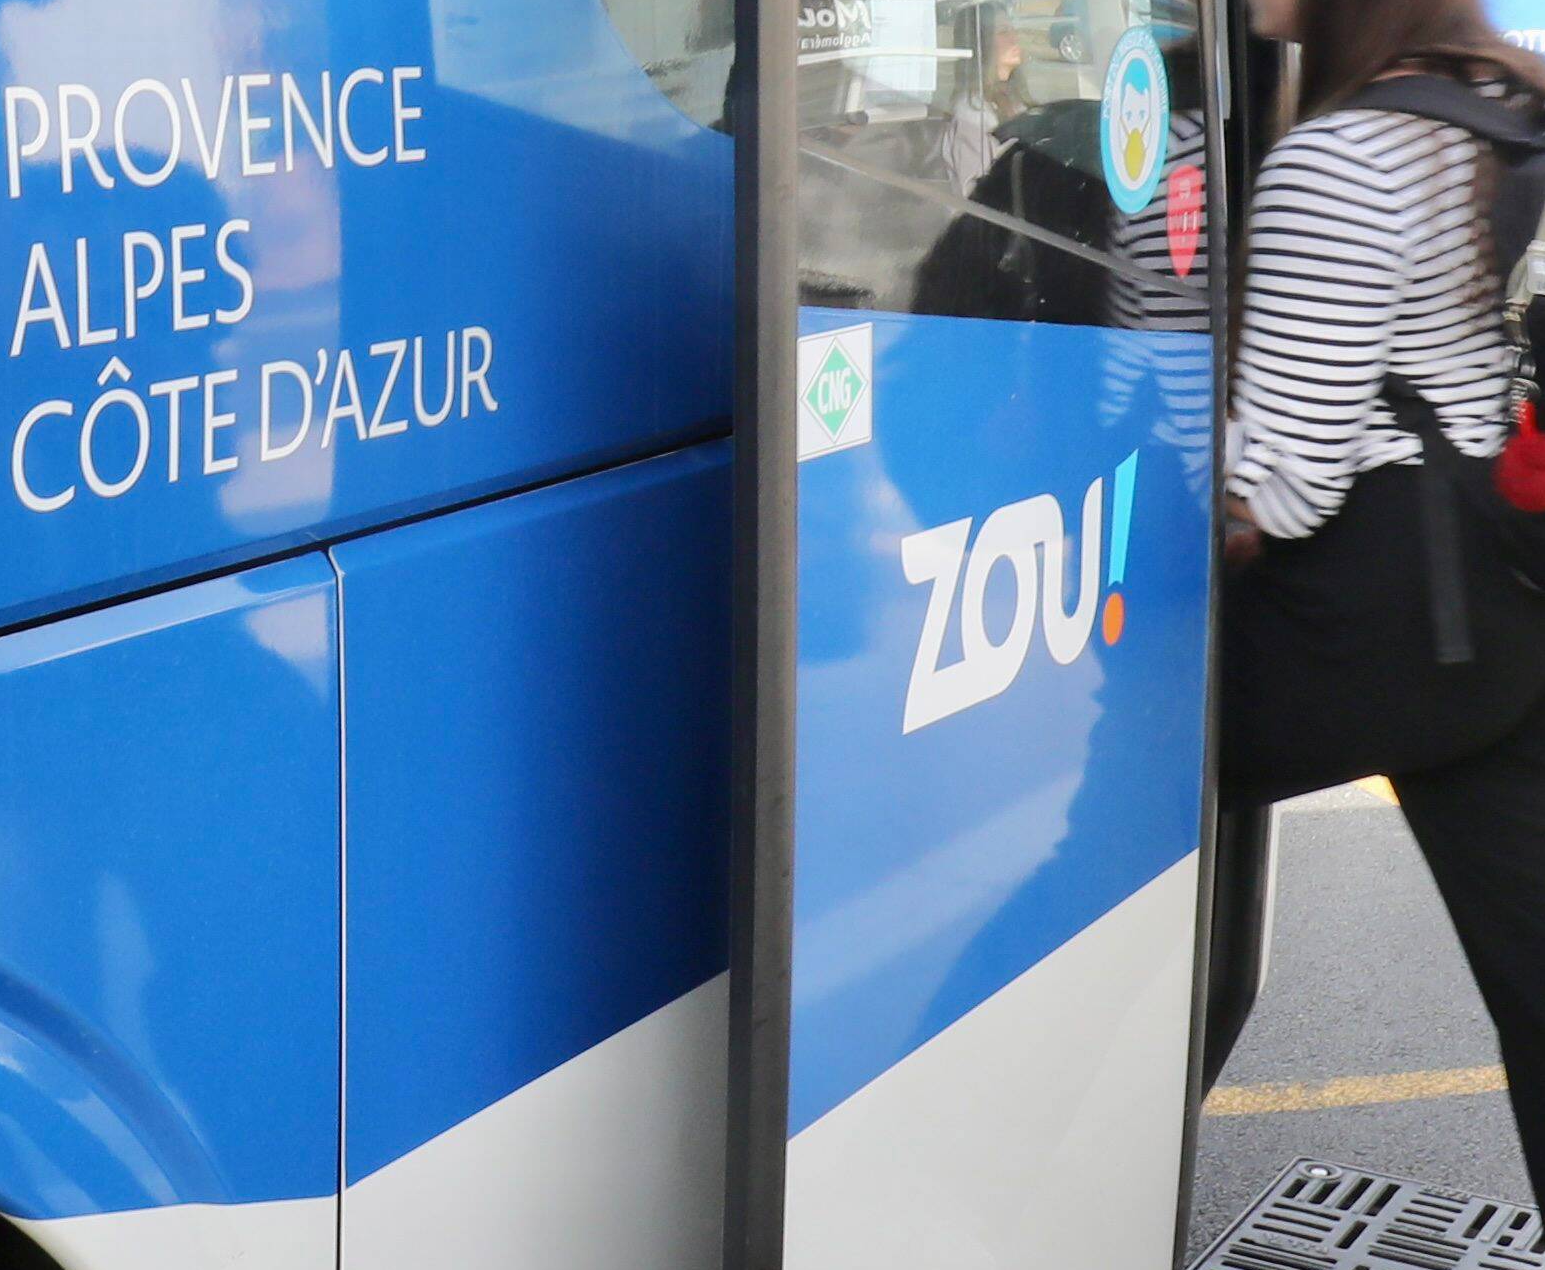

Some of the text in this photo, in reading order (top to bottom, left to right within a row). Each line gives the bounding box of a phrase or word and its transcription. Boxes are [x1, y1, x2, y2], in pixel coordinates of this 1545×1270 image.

[5, 66, 426, 199] PROVENCE
[11, 219, 254, 358] ALPES
[12, 357, 240, 512] CÔTE
[817, 366, 853, 415] CNG
[901, 448, 1139, 734] ZOU!
